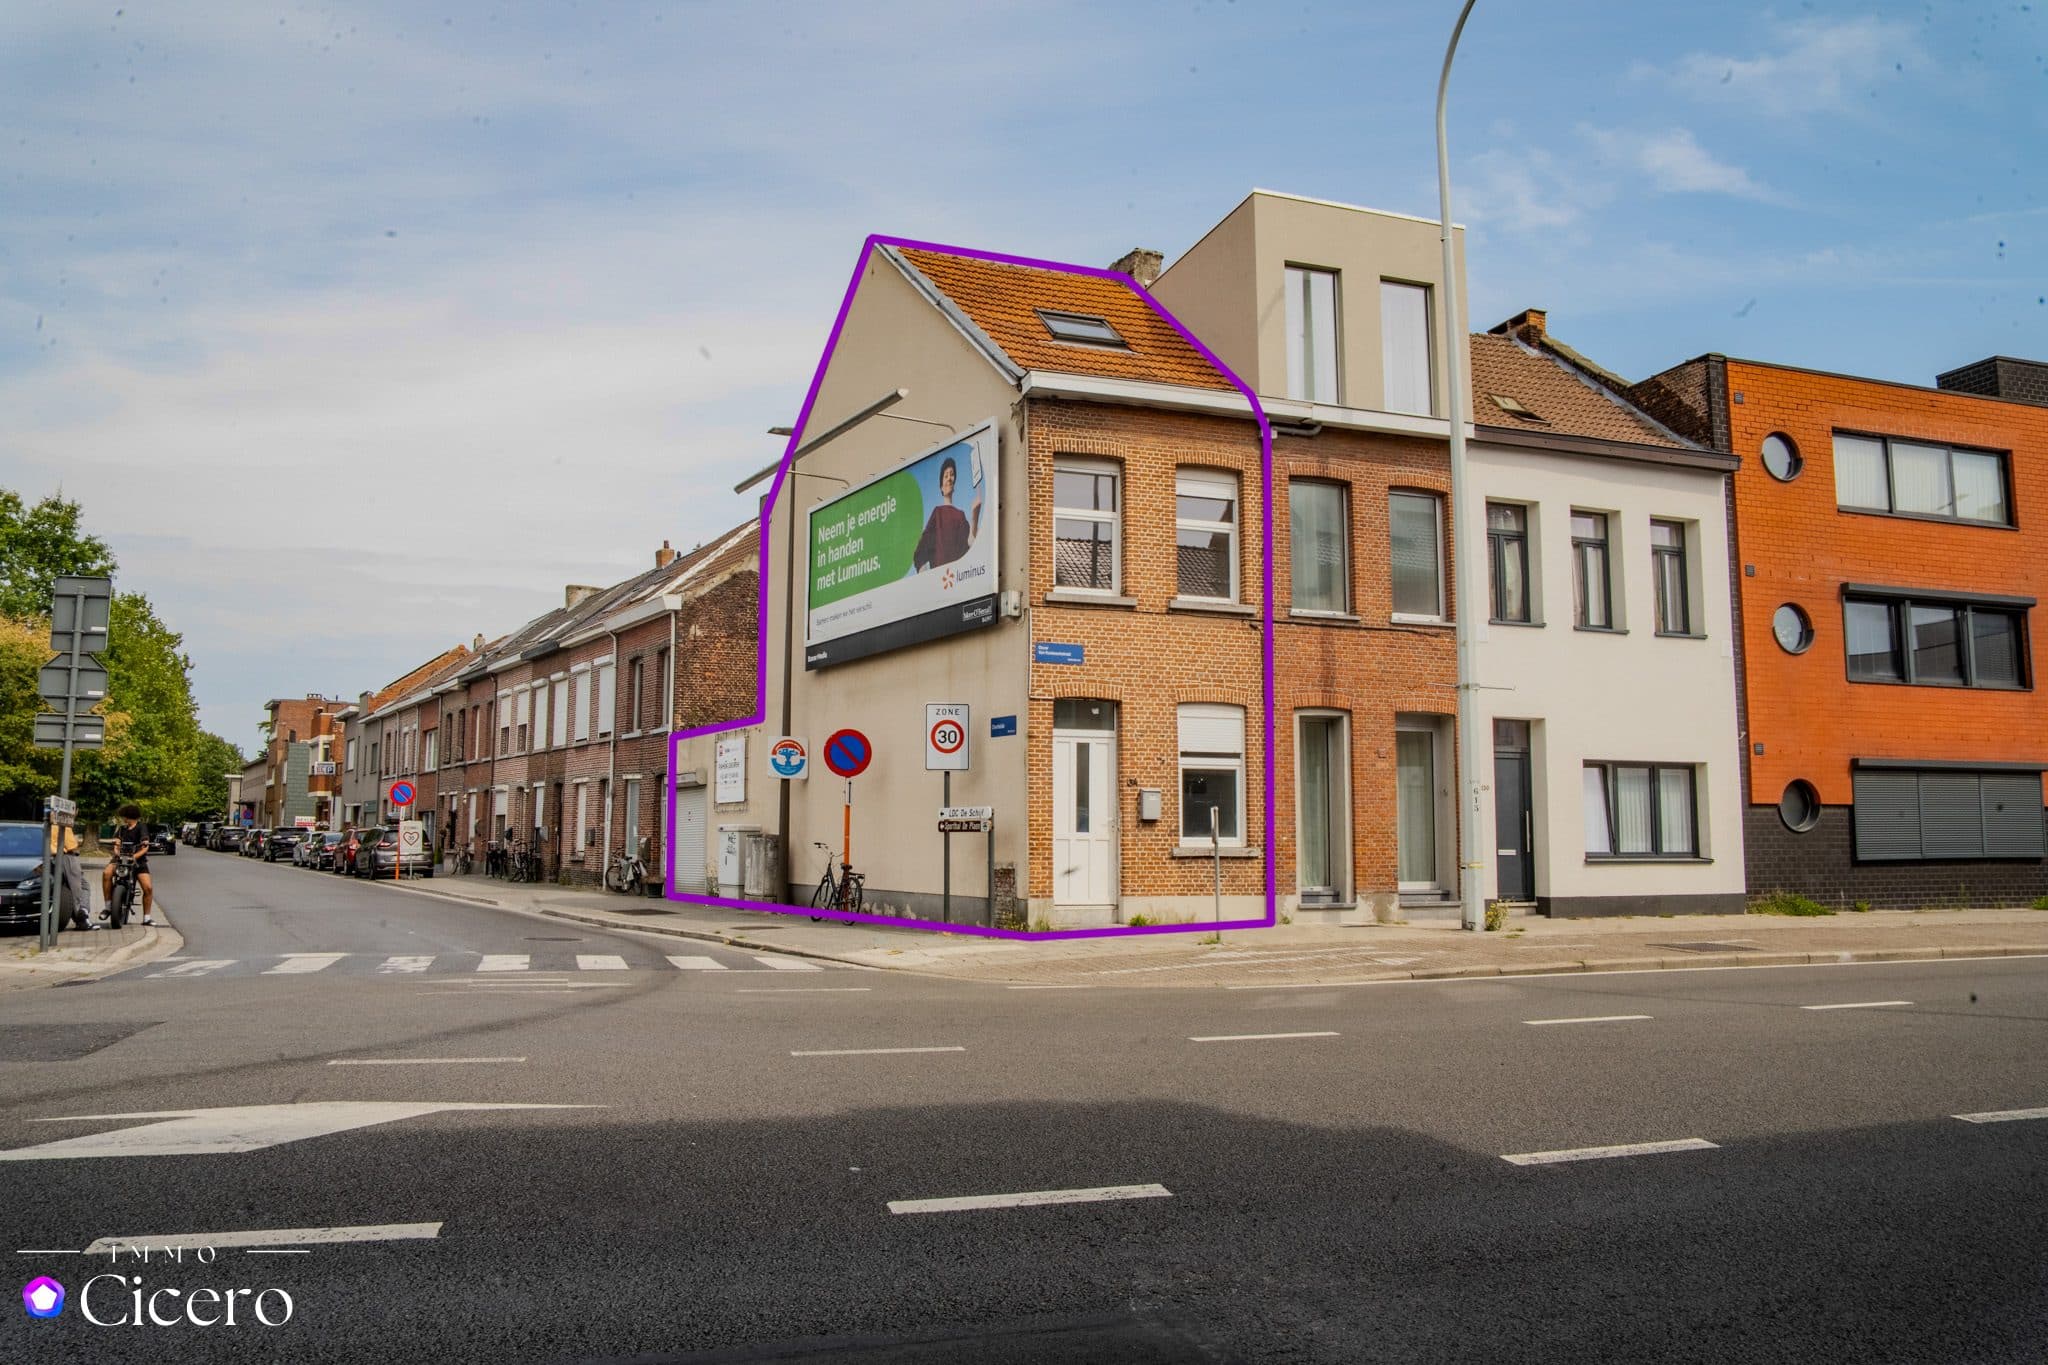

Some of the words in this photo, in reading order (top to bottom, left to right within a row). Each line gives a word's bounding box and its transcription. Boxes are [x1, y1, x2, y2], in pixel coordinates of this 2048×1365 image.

[818, 521, 845, 544] Neem
[846, 513, 856, 537] je
[858, 495, 897, 523] energie
[817, 550, 826, 568] in
[828, 537, 864, 564] handen
[816, 569, 837, 591] met
[838, 555, 881, 583] Luminus.
[956, 564, 986, 583] luminus
[935, 708, 961, 716] ZONE
[937, 730, 958, 744] 30
